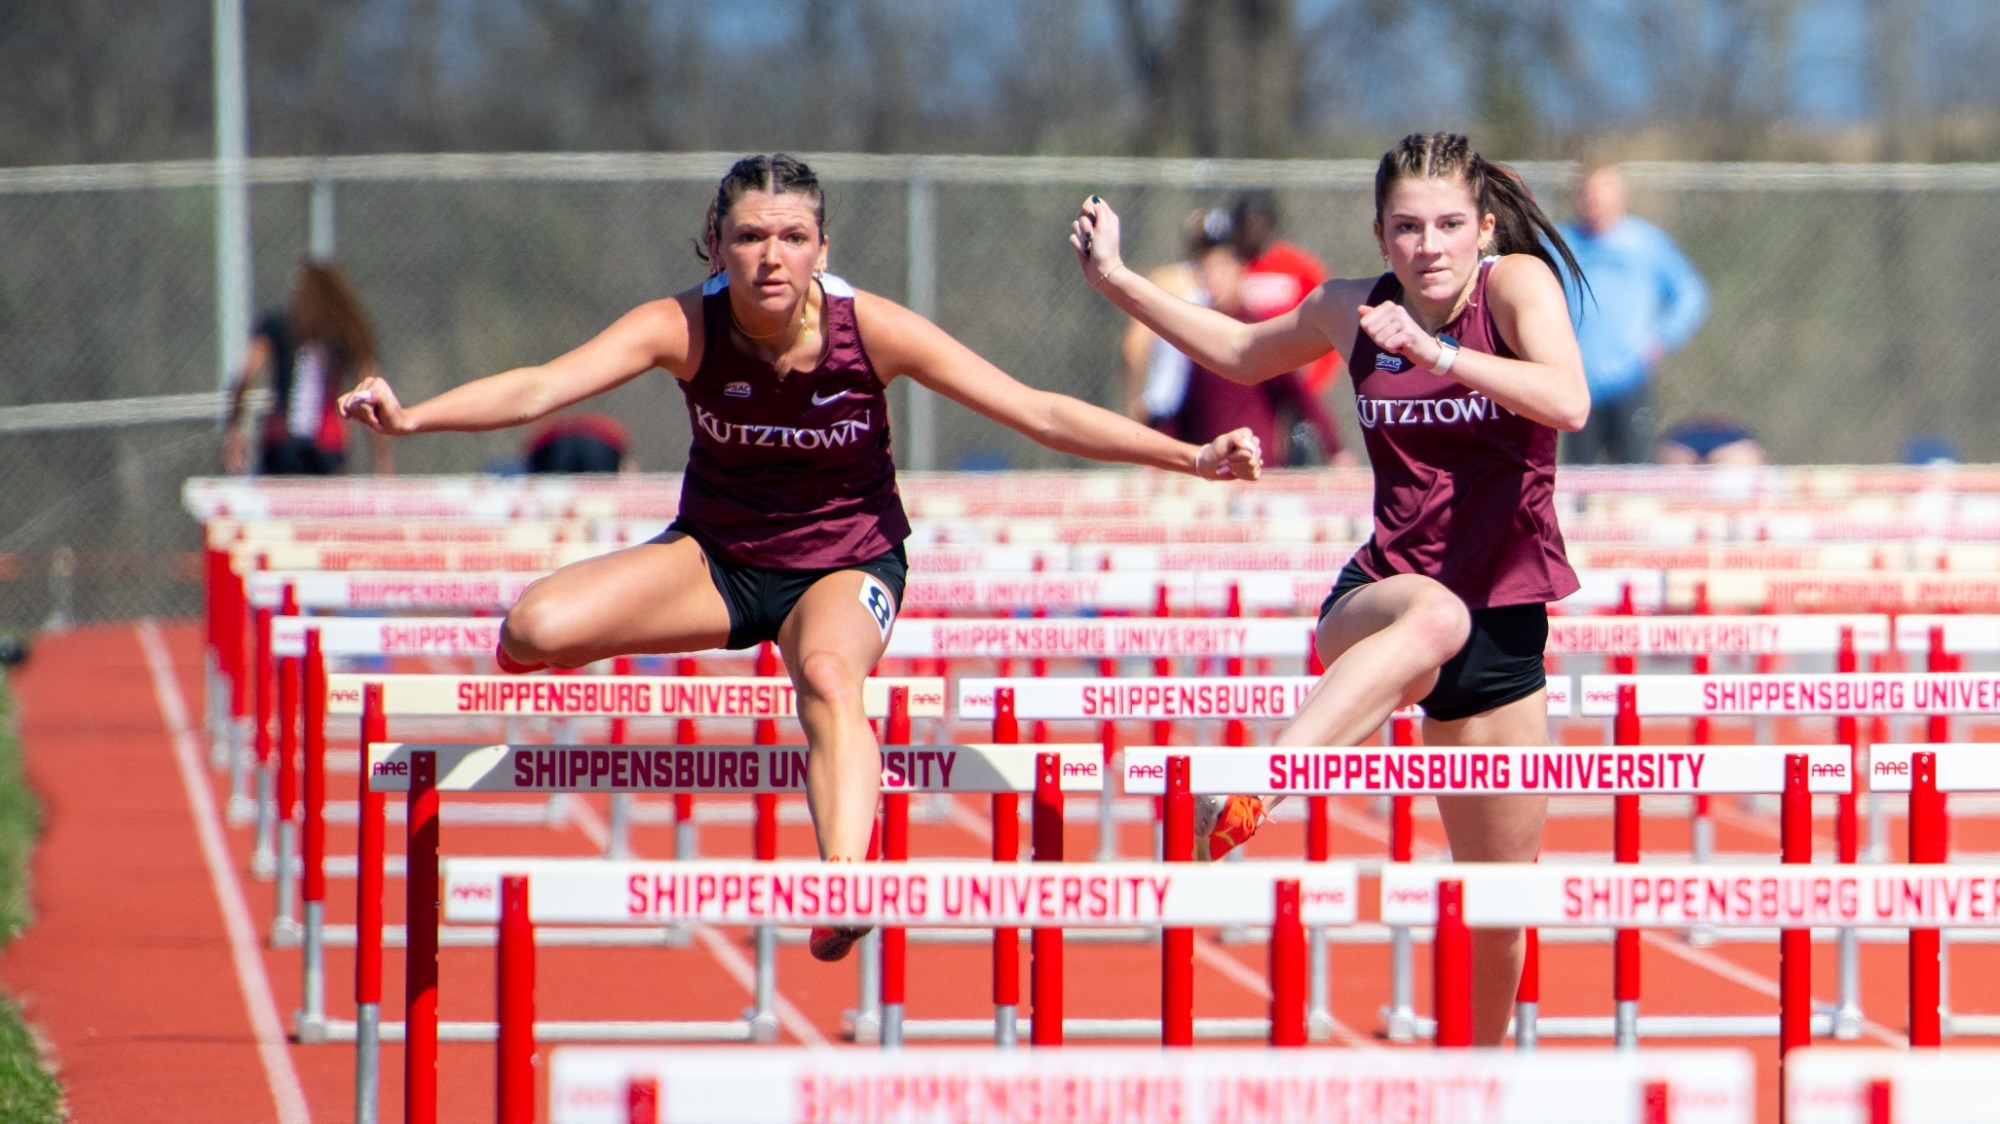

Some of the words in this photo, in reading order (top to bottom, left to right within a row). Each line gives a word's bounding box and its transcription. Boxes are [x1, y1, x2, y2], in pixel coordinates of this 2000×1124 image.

[694, 402, 870, 449] KUTZTOWN
[868, 586, 890, 629] 8
[380, 625, 499, 650] SHIPPENS
[932, 626, 1105, 651] SHIPPENSBURG
[1114, 627, 1247, 651] UNIVERSITY
[1550, 624, 1641, 650] NSBURG
[1649, 624, 1779, 651] UNIVERSITY
[458, 682, 650, 713] SHIPPENSBURG
[661, 684, 795, 715] UNIVERSIT
[1083, 685, 1285, 715] SHIPPENSBURG
[1703, 681, 1904, 710] SHIPPENSBURG
[515, 751, 759, 787] SHIPPENSBURG
[769, 751, 957, 788] UNSITY
[1269, 754, 1510, 789] SHIPPENSBURG
[1521, 754, 1705, 789] UNIVERSITY
[628, 874, 927, 916] SHIPPENSBURG
[943, 876, 1171, 917] UNIVERSITY
[1564, 877, 1858, 918] SHIPPENSBURG
